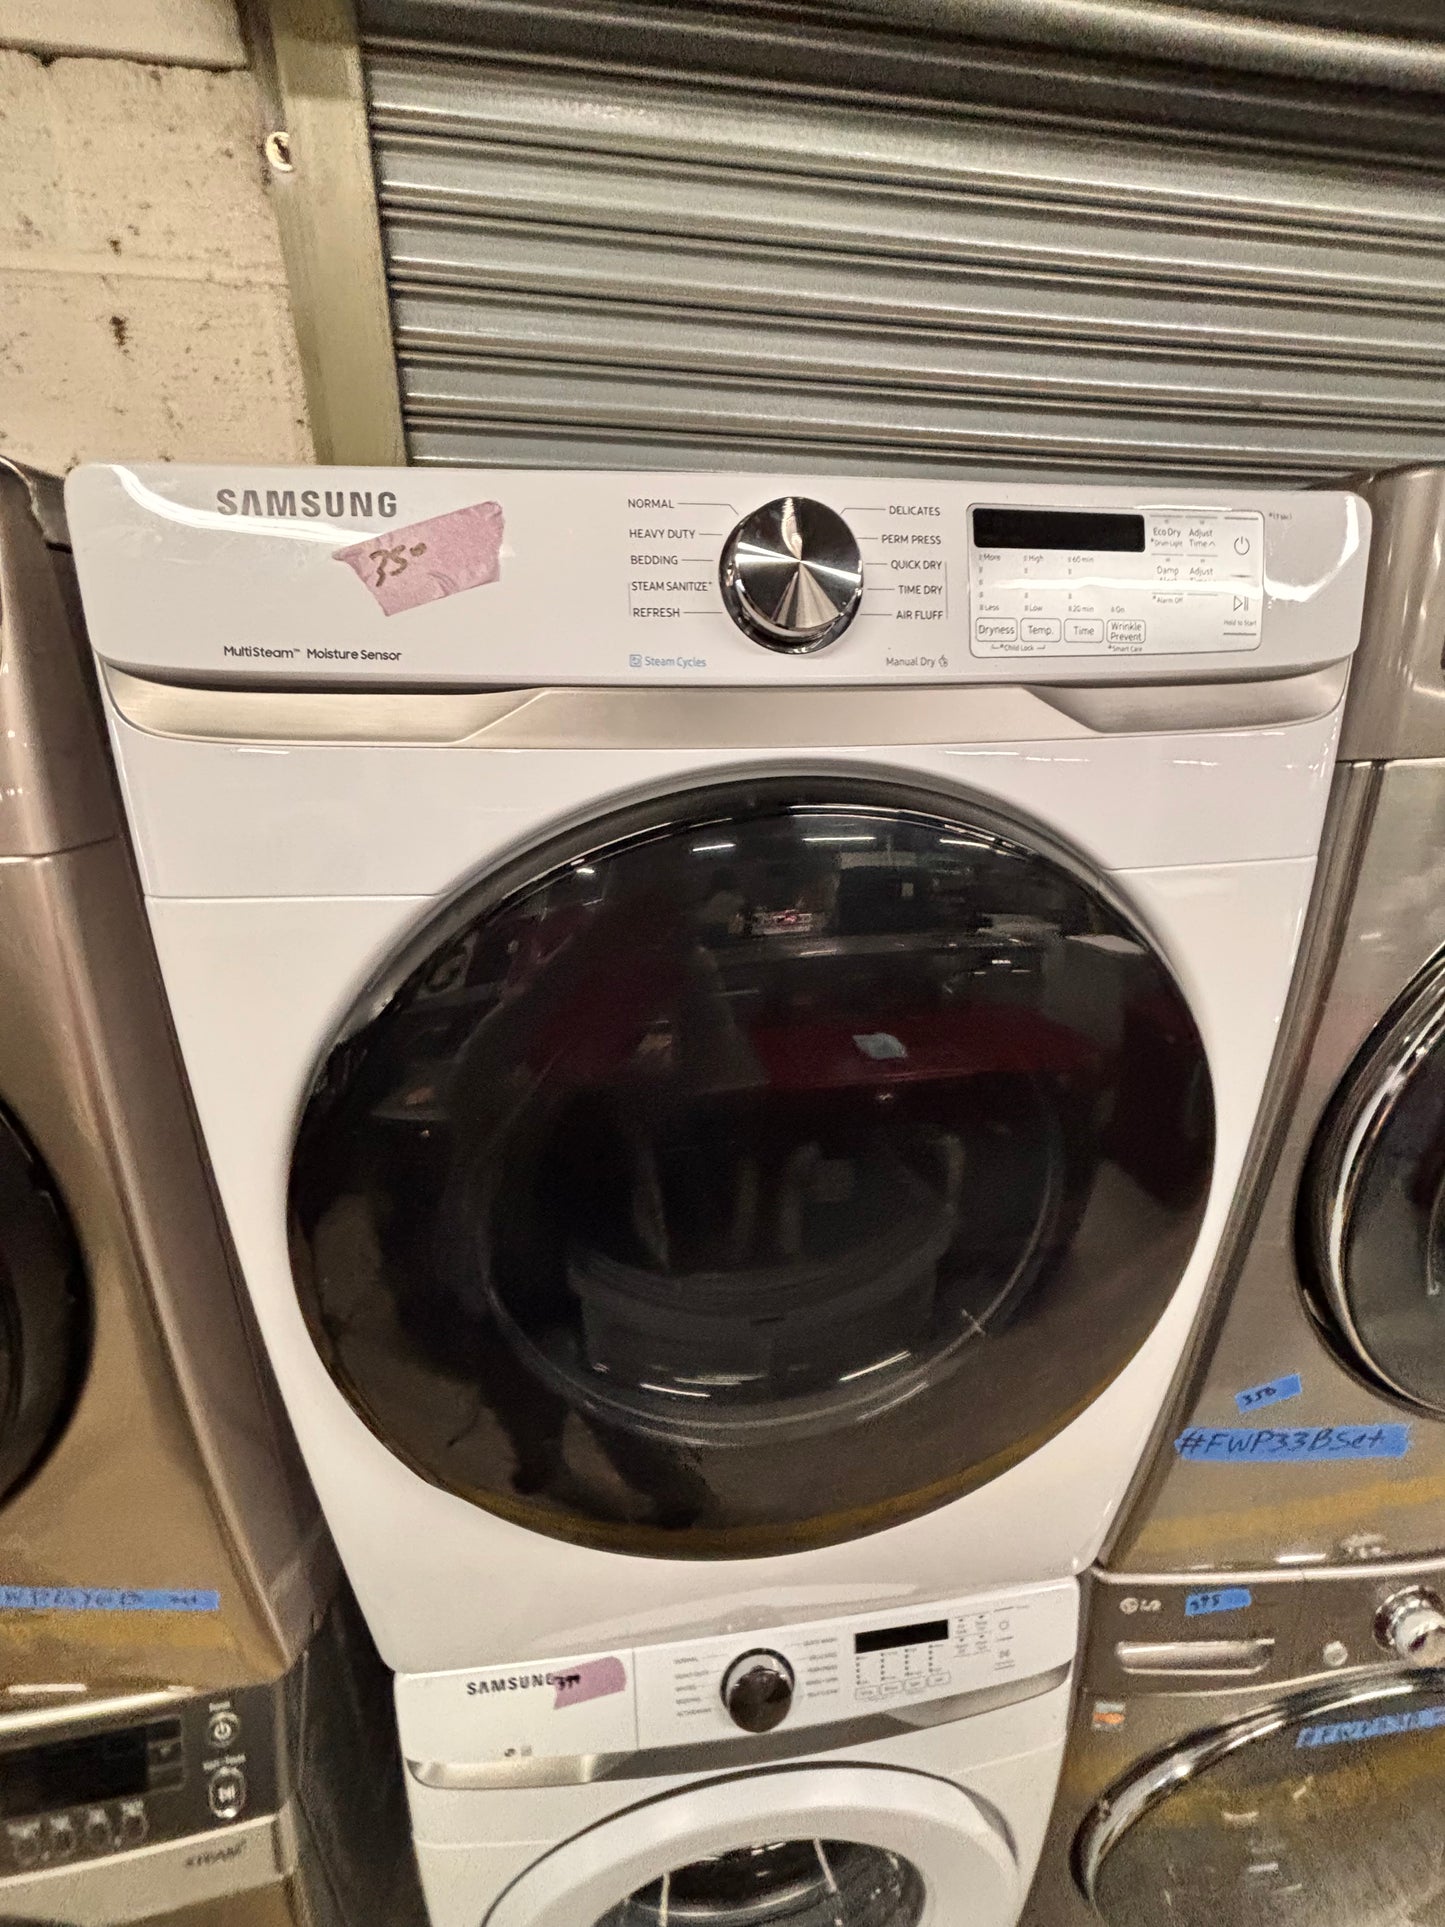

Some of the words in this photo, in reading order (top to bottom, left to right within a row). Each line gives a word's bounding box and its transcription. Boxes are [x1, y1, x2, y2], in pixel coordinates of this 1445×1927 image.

[217, 488, 397, 517] SAMSUNG
[627, 498, 675, 509] NORMAL
[889, 505, 941, 516] DELICATES
[629, 529, 666, 539] HEAVY
[667, 529, 695, 539] DUTY
[1153, 527, 1167, 537] Eco
[1167, 528, 1181, 538] Dry
[1189, 528, 1213, 538] Adjust
[881, 534, 910, 544] PERM
[911, 534, 942, 545] PRESS
[630, 555, 678, 565] BEDDING
[890, 559, 921, 570] QUICK
[922, 560, 942, 570] DRY
[1156, 566, 1179, 576] Damp
[1189, 567, 1213, 577] Adjust
[631, 581, 665, 591] STEAM
[898, 584, 922, 595] TIME
[923, 585, 943, 595] DRY
[633, 607, 680, 617] REFRESH
[896, 610, 913, 620] AIR
[914, 610, 943, 620] FLUFF
[978, 625, 1015, 636] Dryness
[1028, 625, 1054, 636] Temp.
[1073, 625, 1095, 635] Time
[1111, 622, 1142, 632] Wrinkle
[1110, 632, 1142, 642] Prevent
[307, 647, 359, 660] Moisture
[361, 649, 402, 661] Sensor
[644, 656, 675, 666] Steam
[676, 656, 707, 669] Cycles
[885, 656, 918, 667] Manual
[920, 657, 936, 669] Dry
